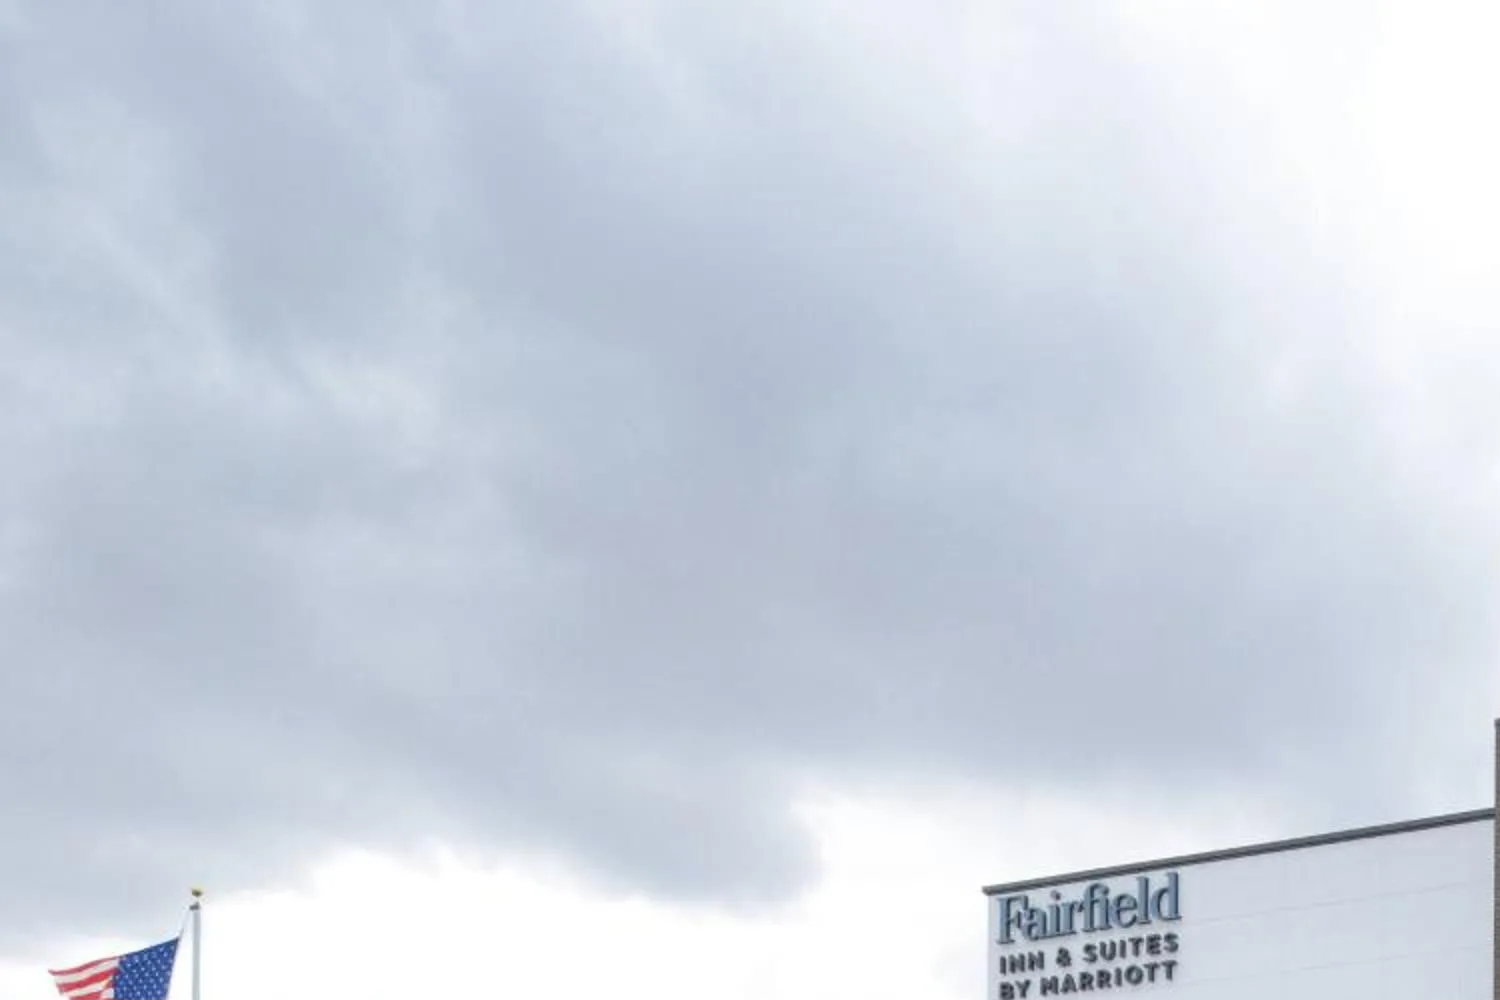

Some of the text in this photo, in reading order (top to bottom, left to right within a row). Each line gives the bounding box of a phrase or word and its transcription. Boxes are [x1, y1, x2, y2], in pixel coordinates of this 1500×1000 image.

[996, 871, 1182, 944] Fairfield
[999, 932, 1180, 976] INN & SUITES
[999, 959, 1179, 1000] BY MARRIOTT
